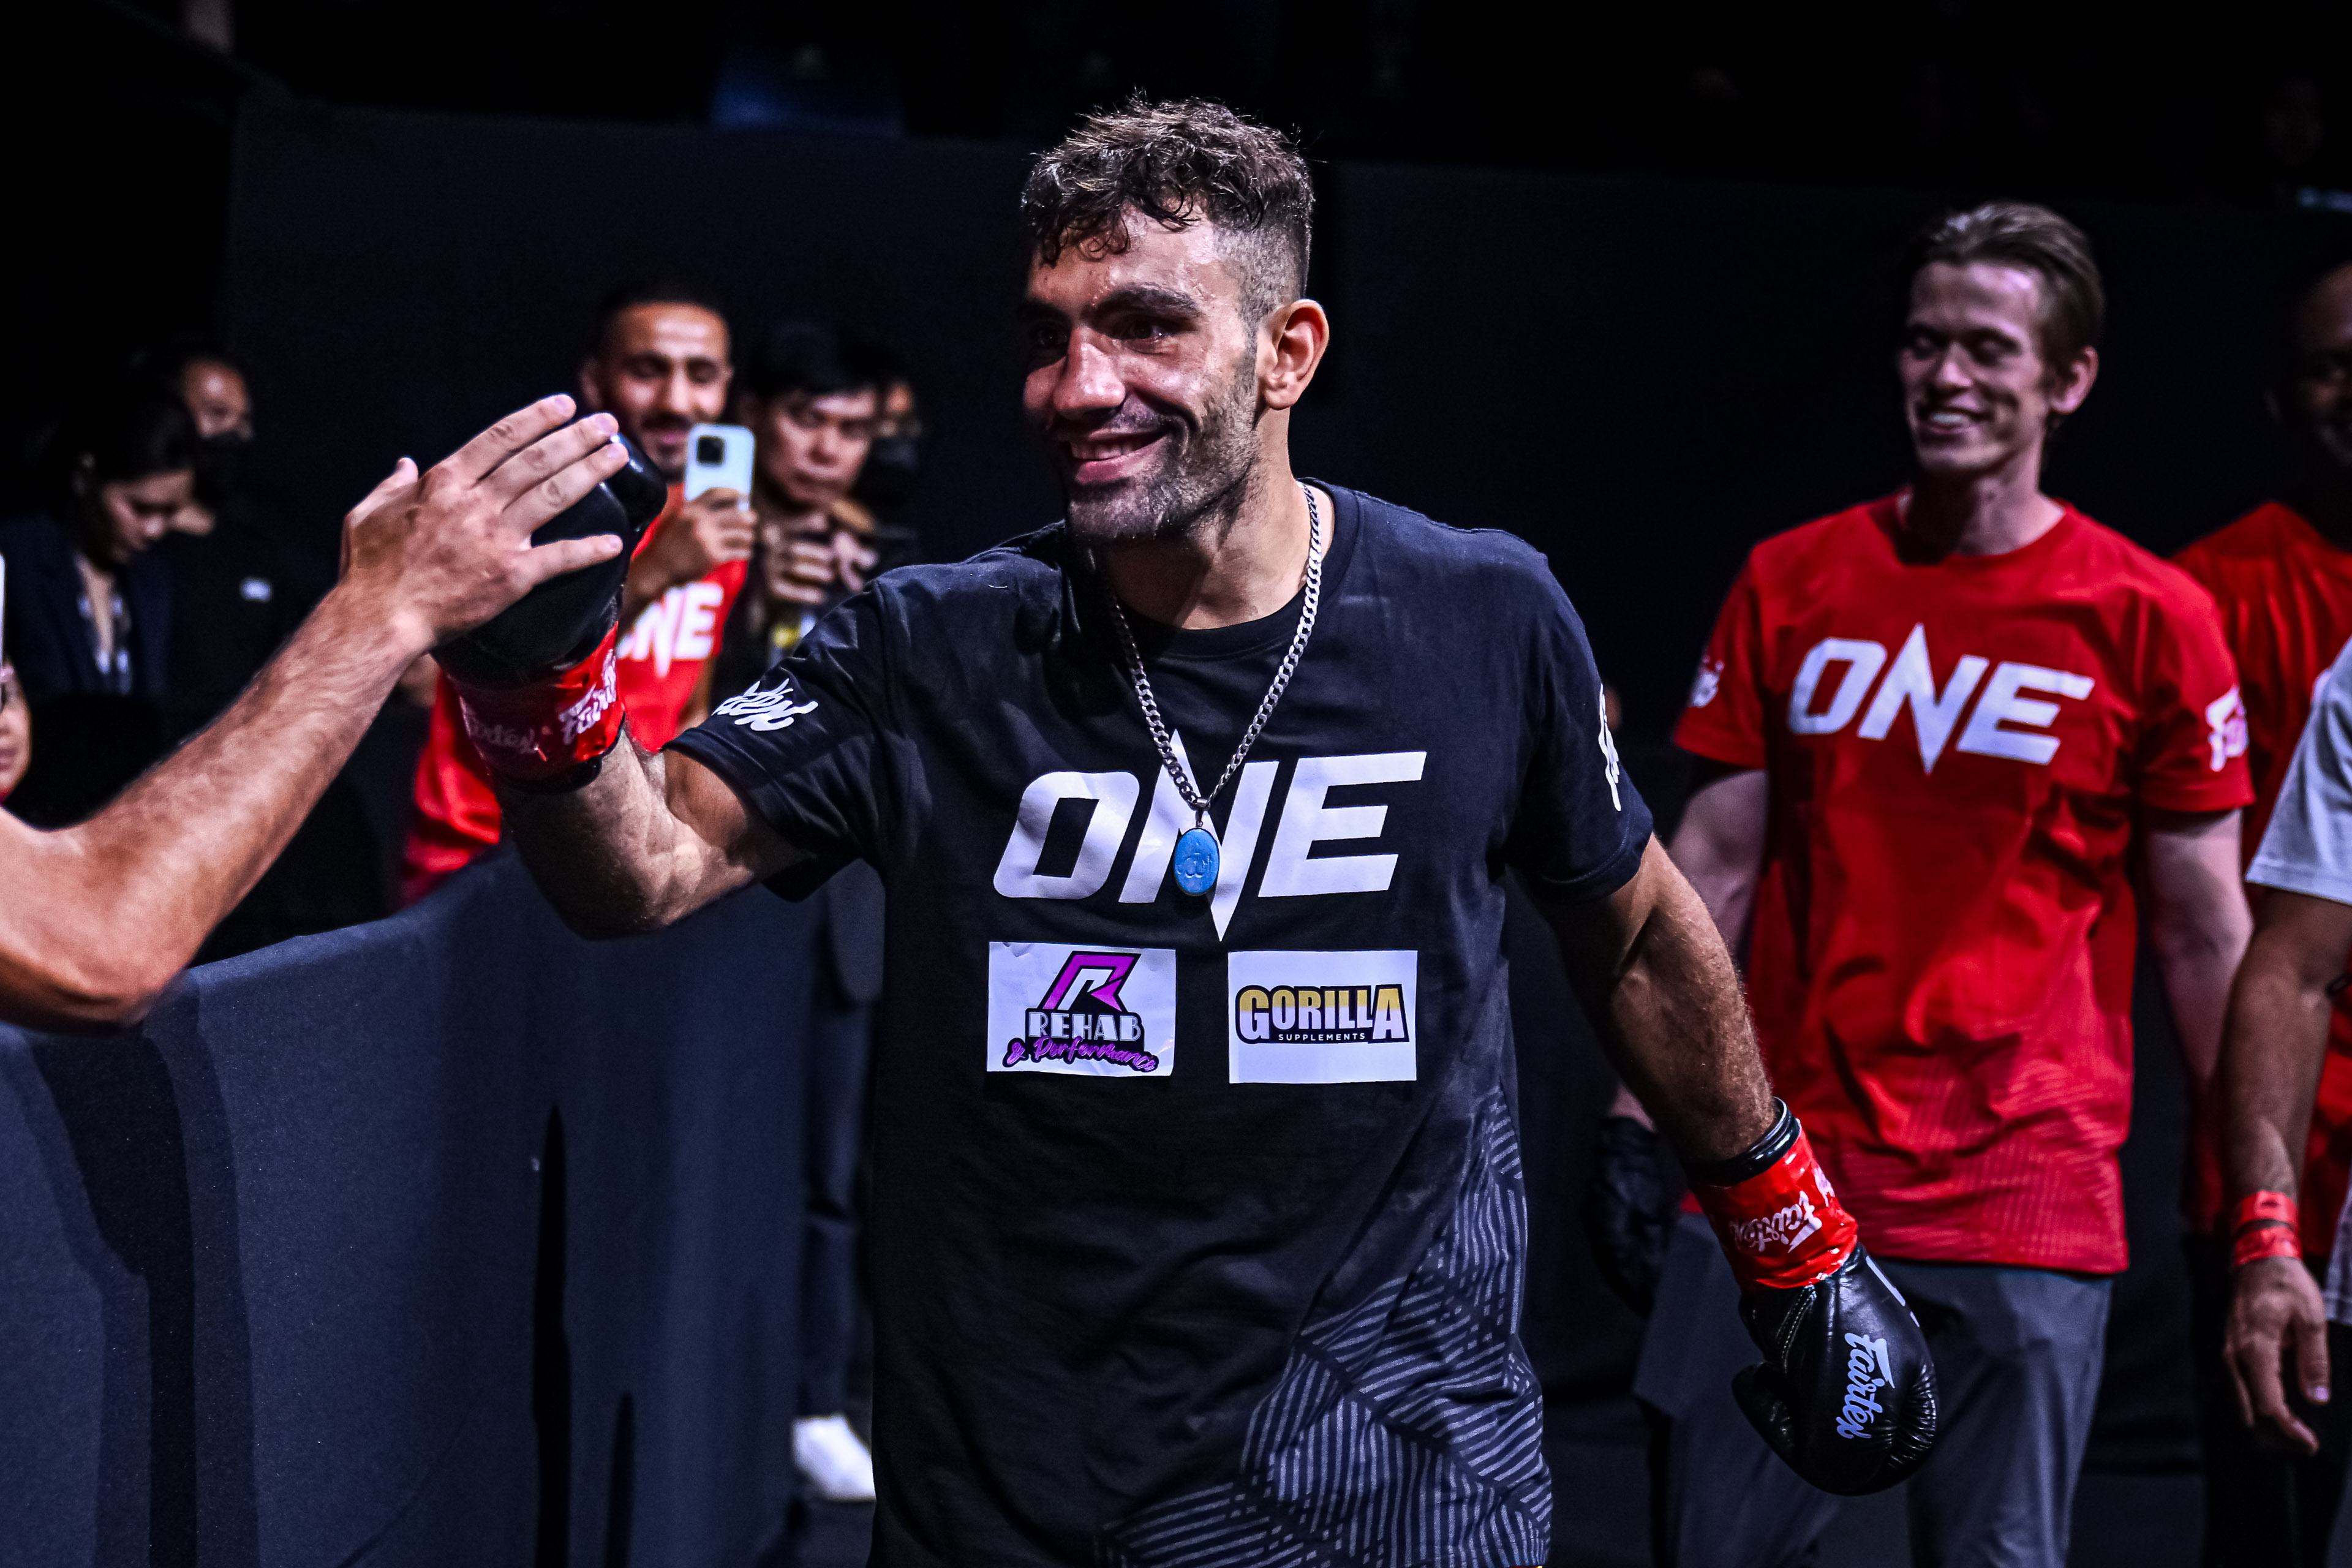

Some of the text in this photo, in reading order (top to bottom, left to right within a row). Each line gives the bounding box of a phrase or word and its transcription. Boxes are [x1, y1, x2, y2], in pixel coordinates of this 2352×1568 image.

[617, 582, 724, 677] NE
[1787, 622, 2095, 775] ONE
[993, 728, 1427, 941] ONE
[1028, 1011, 1142, 1042] REHAB
[1238, 987, 1405, 1041] GORILLA
[1278, 1032, 1366, 1041] SUPPLEMENTS
[1033, 1035, 1157, 1071] Performance
[1836, 1332, 1896, 1440] Fairtex
